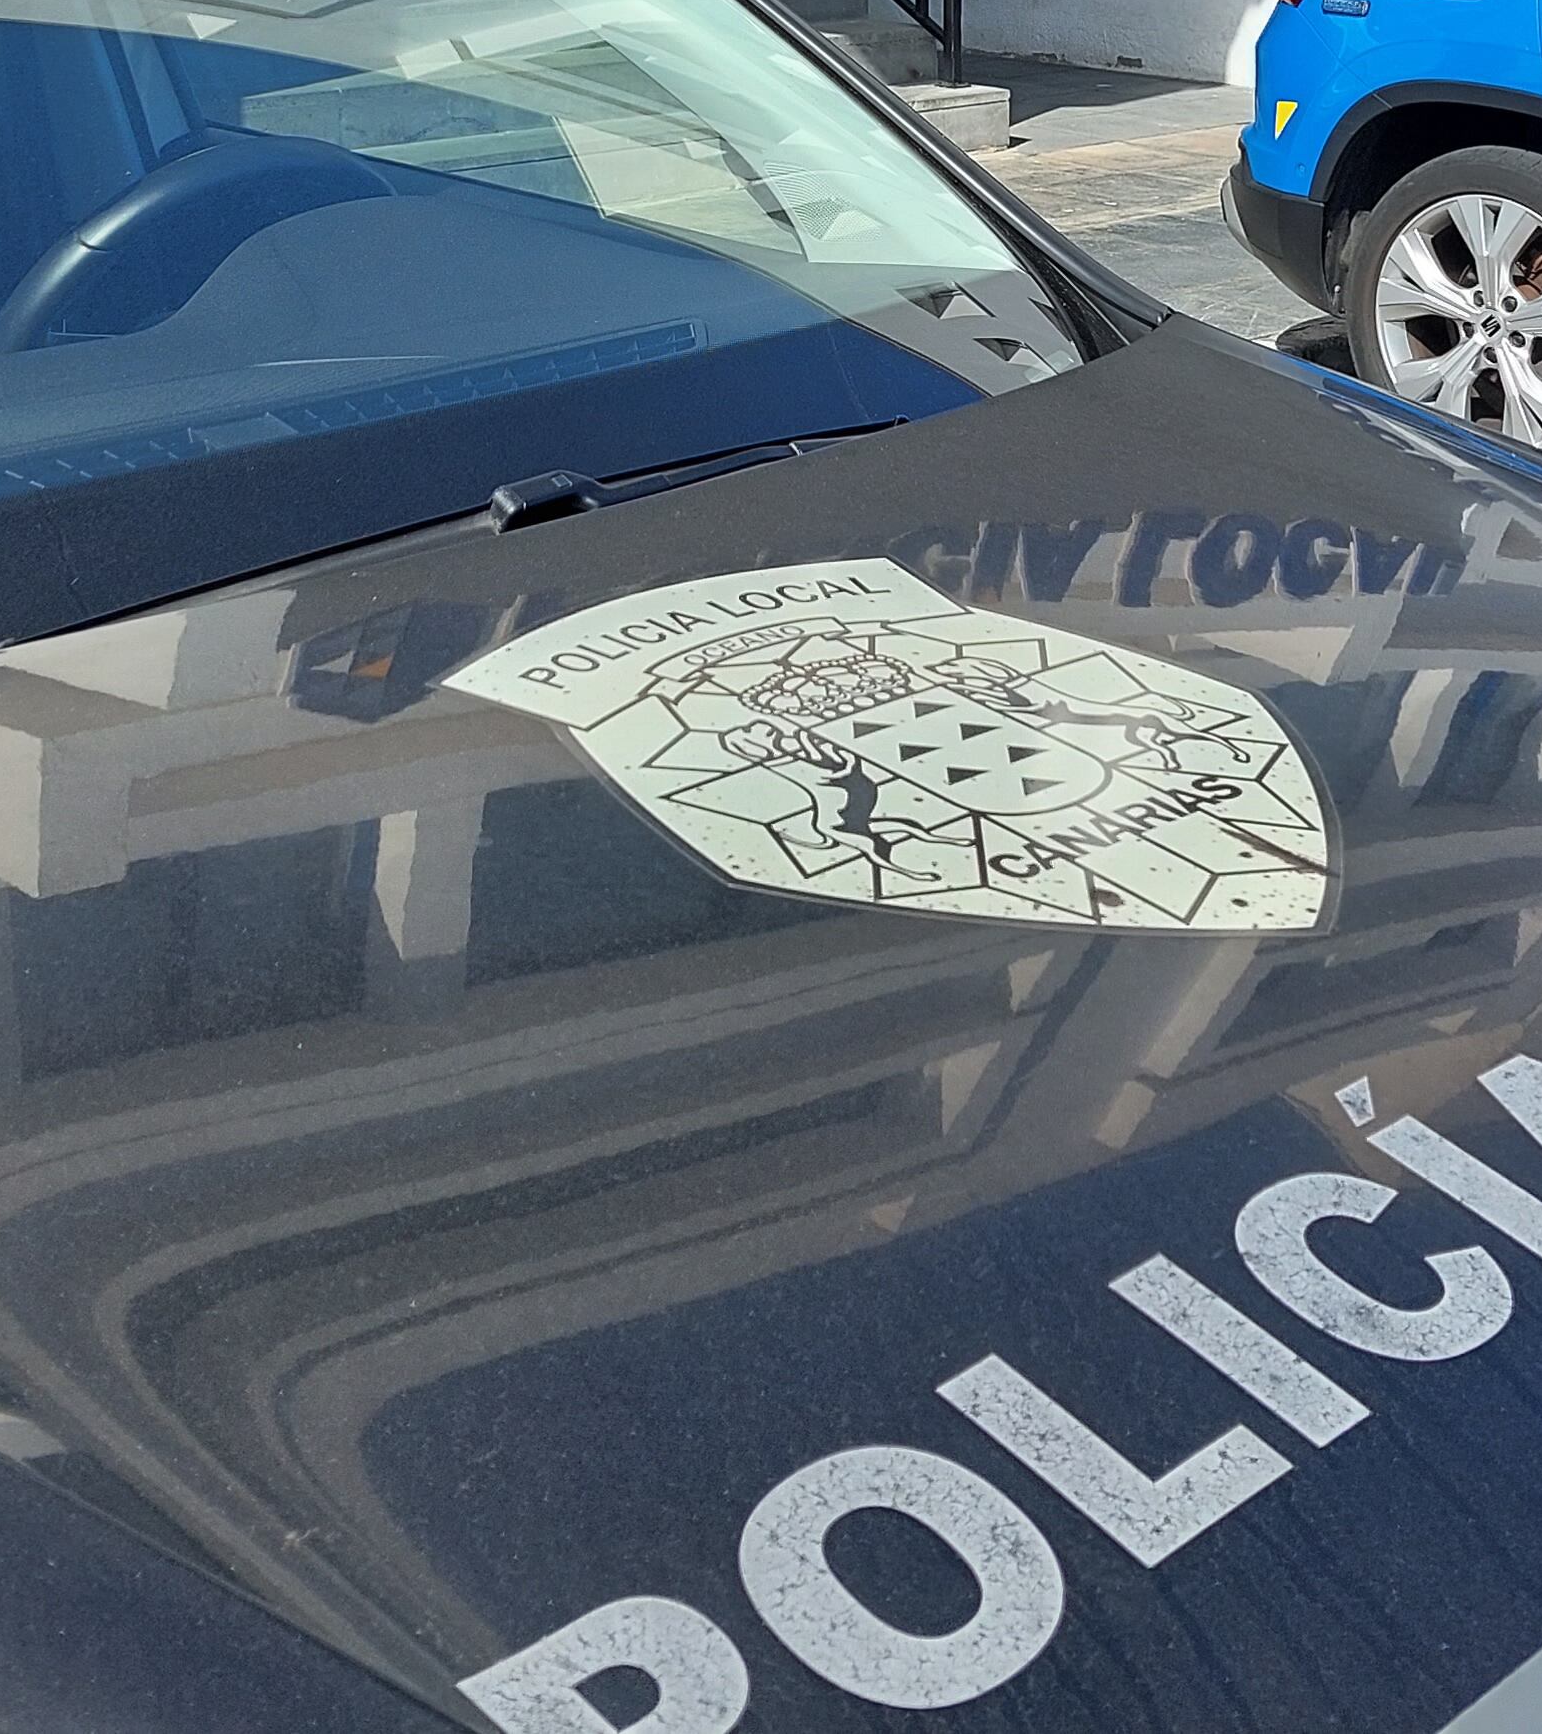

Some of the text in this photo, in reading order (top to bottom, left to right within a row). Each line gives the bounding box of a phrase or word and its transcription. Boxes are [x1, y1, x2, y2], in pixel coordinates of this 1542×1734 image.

[518, 575, 892, 690] POLICIA LOCAL
[682, 623, 806, 667] OCEANO
[987, 776, 1244, 879] CANARIAS
